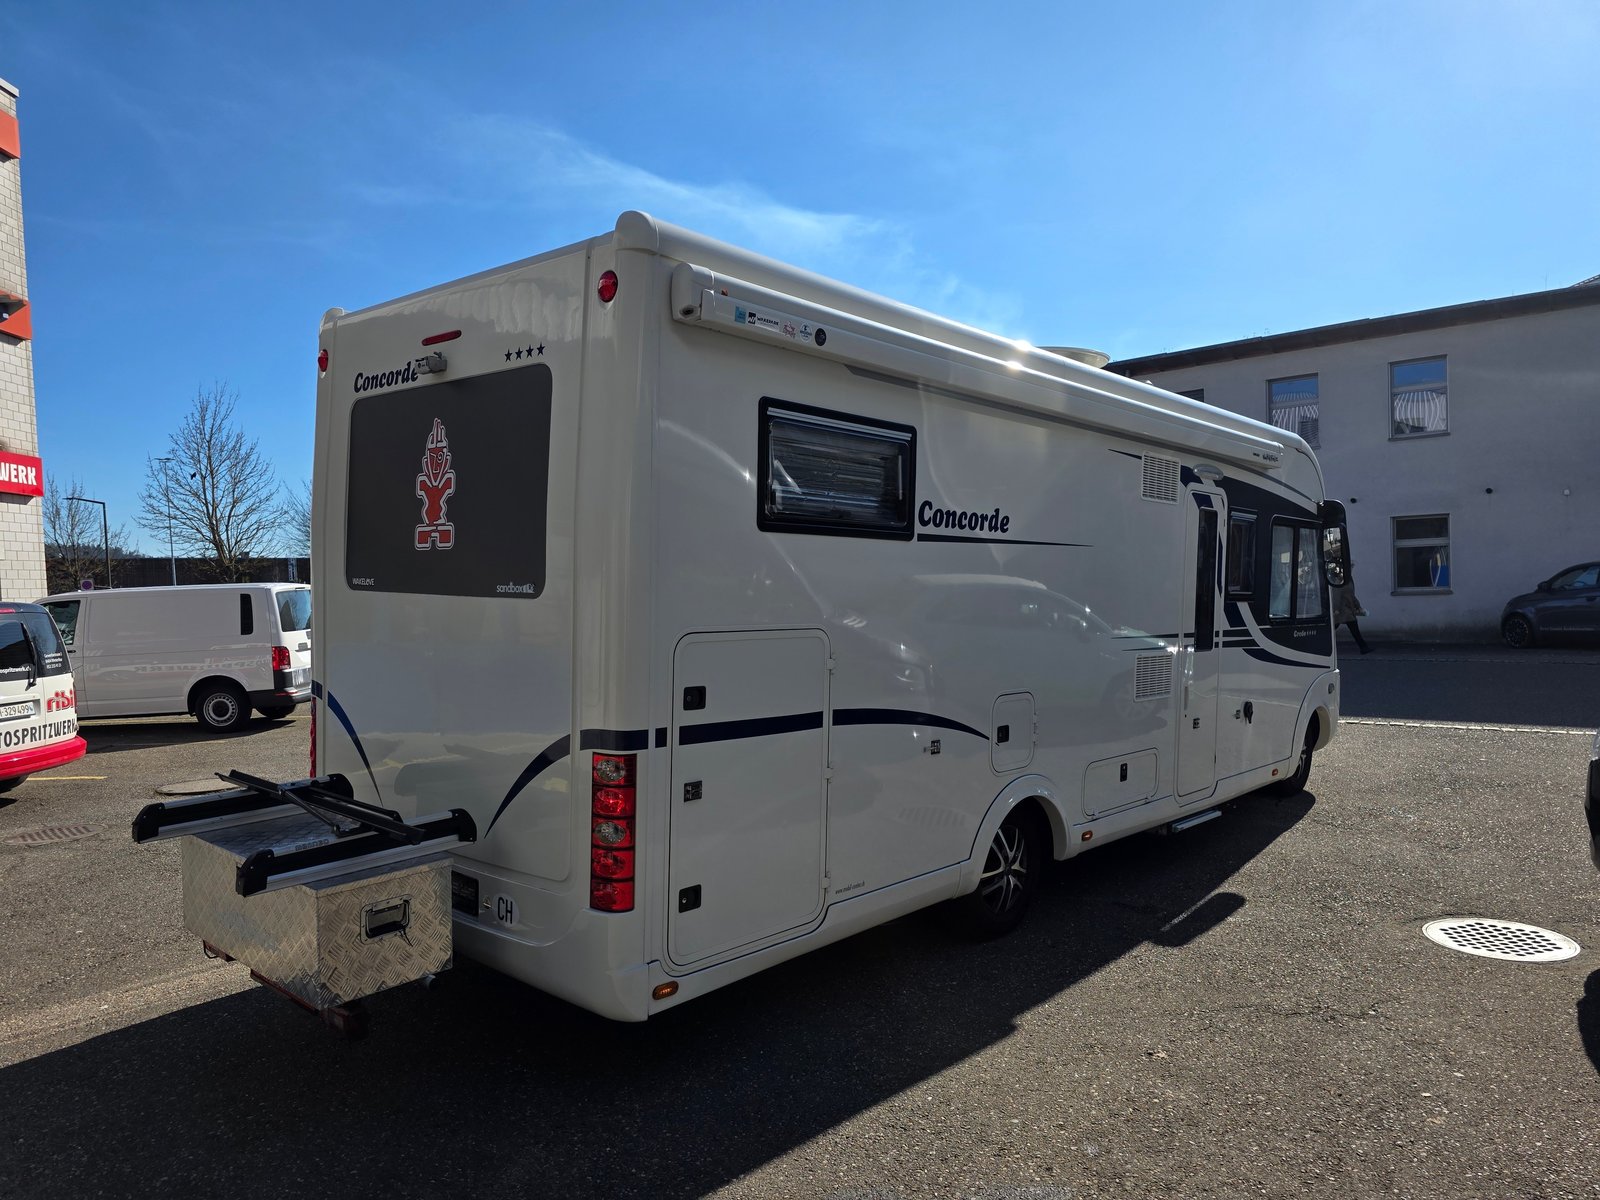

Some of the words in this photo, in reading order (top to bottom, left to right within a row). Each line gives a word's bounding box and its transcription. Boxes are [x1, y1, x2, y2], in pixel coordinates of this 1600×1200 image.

[918, 500, 1010, 533] Concorde
[47, 689, 74, 712] ribi
[497, 896, 513, 924] CH
